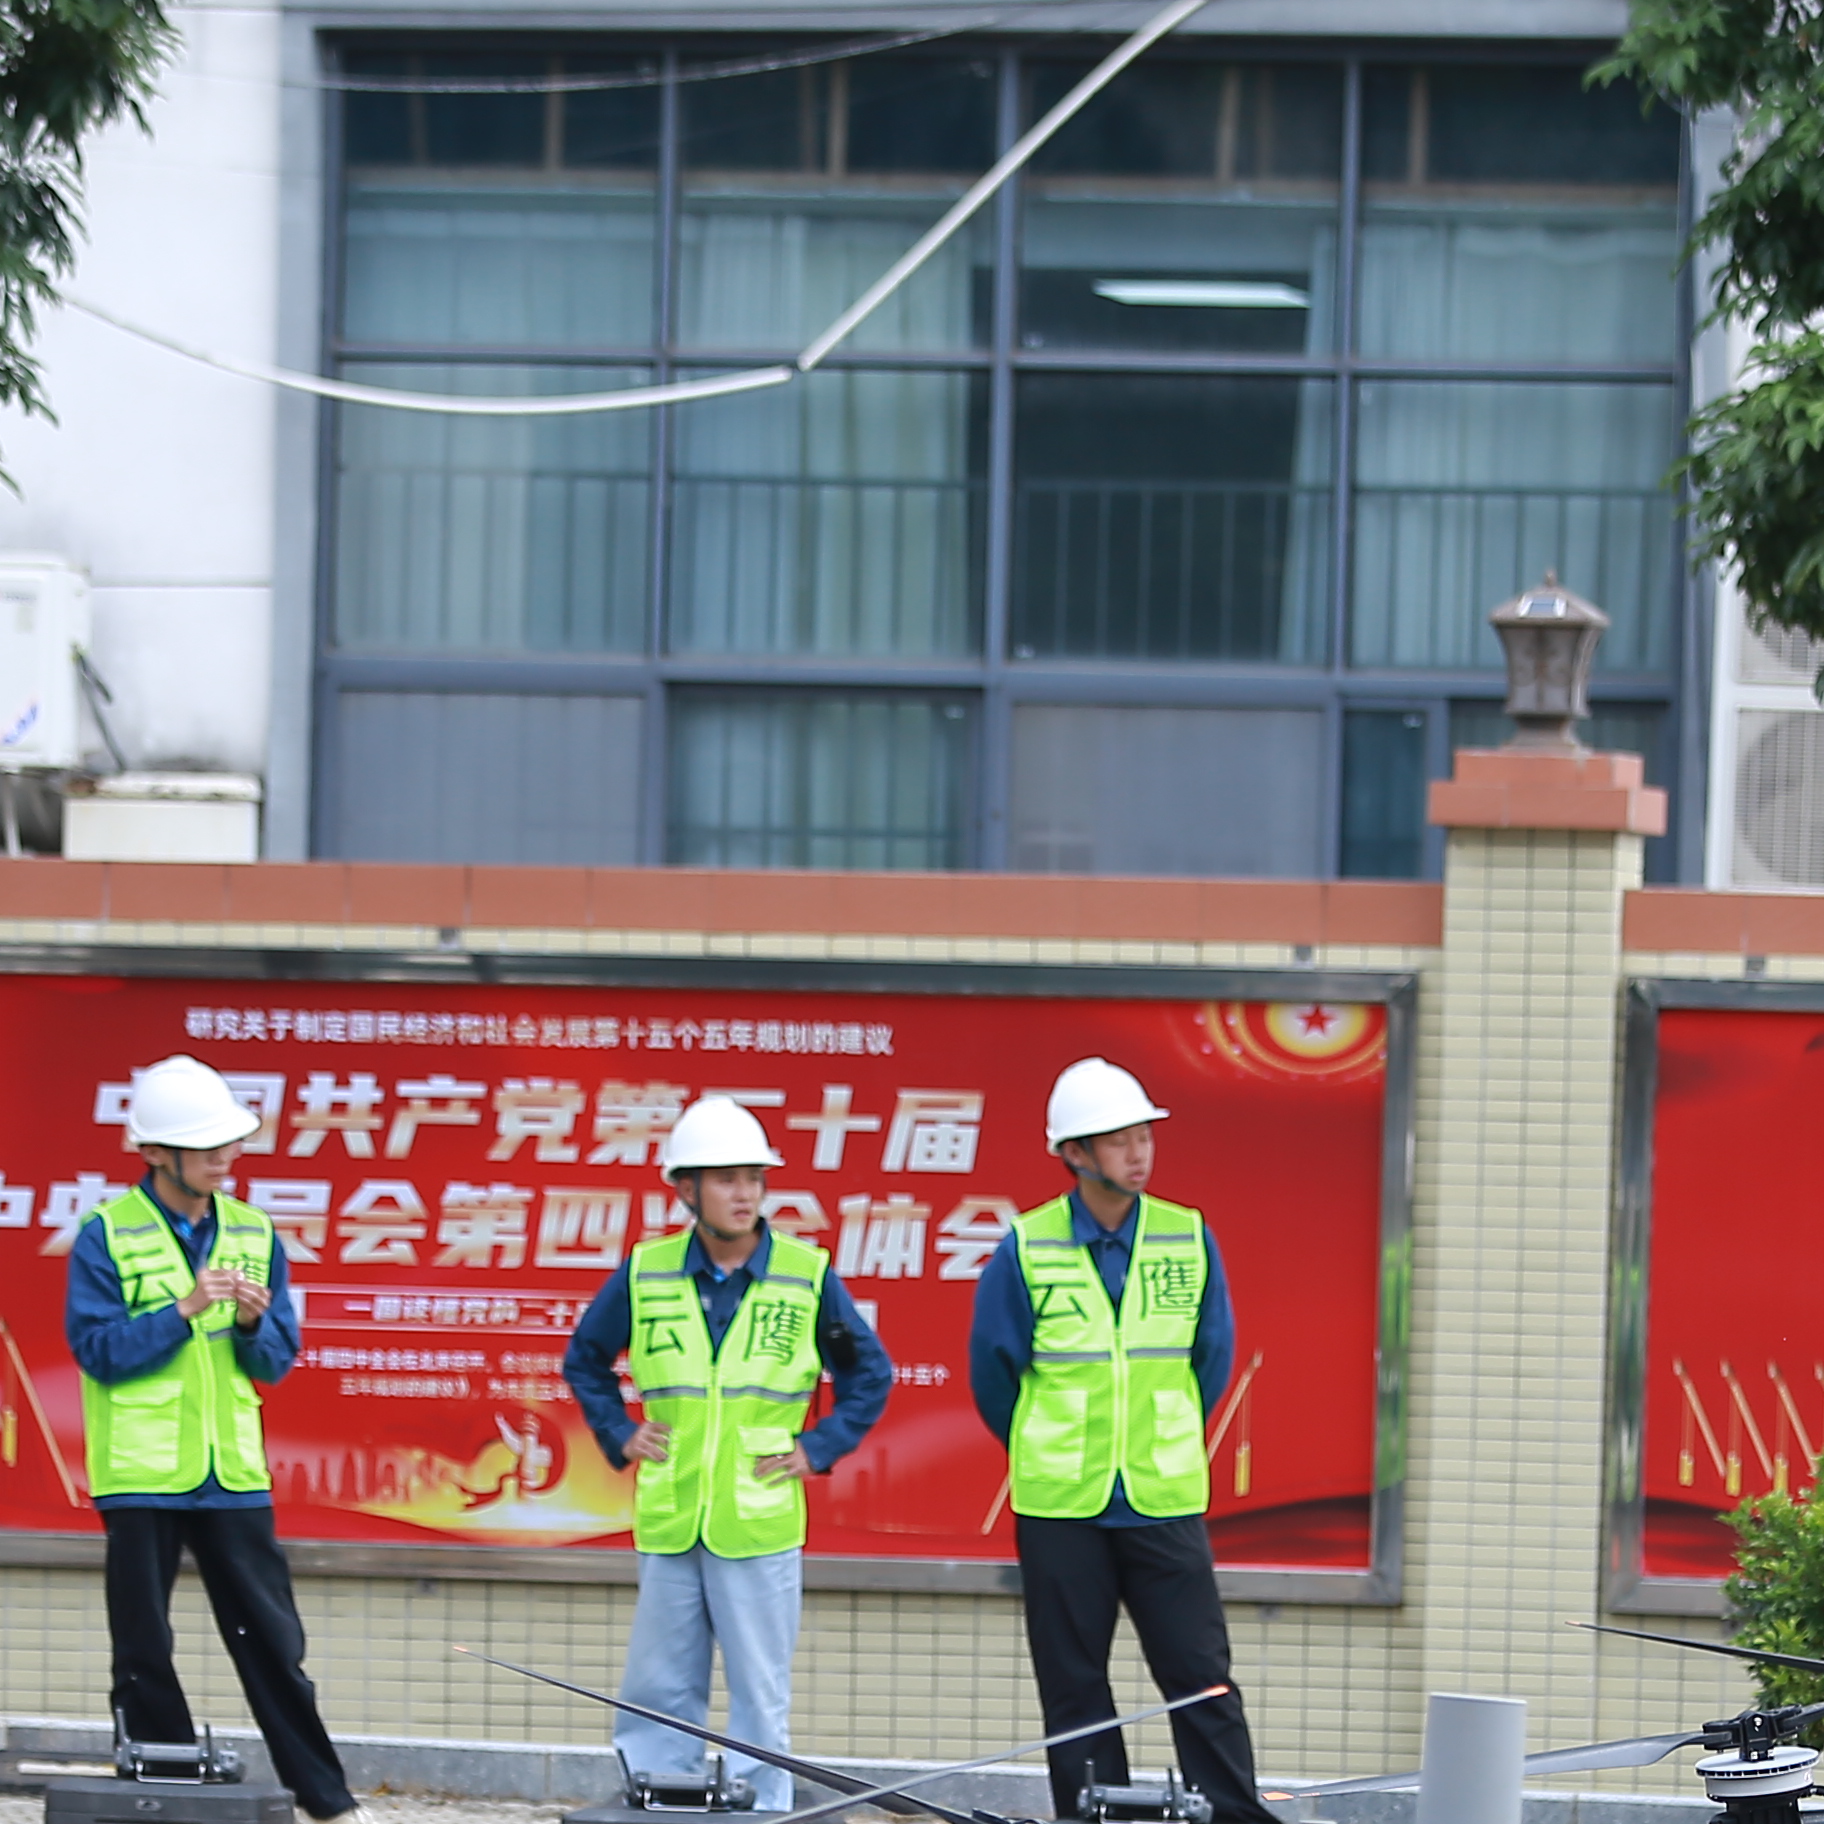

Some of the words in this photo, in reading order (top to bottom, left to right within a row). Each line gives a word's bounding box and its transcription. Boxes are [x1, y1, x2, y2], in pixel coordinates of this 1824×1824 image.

[185, 1006, 895, 1056] 研究关于制定国民经济和社会发展第十五个五年规划的建议
